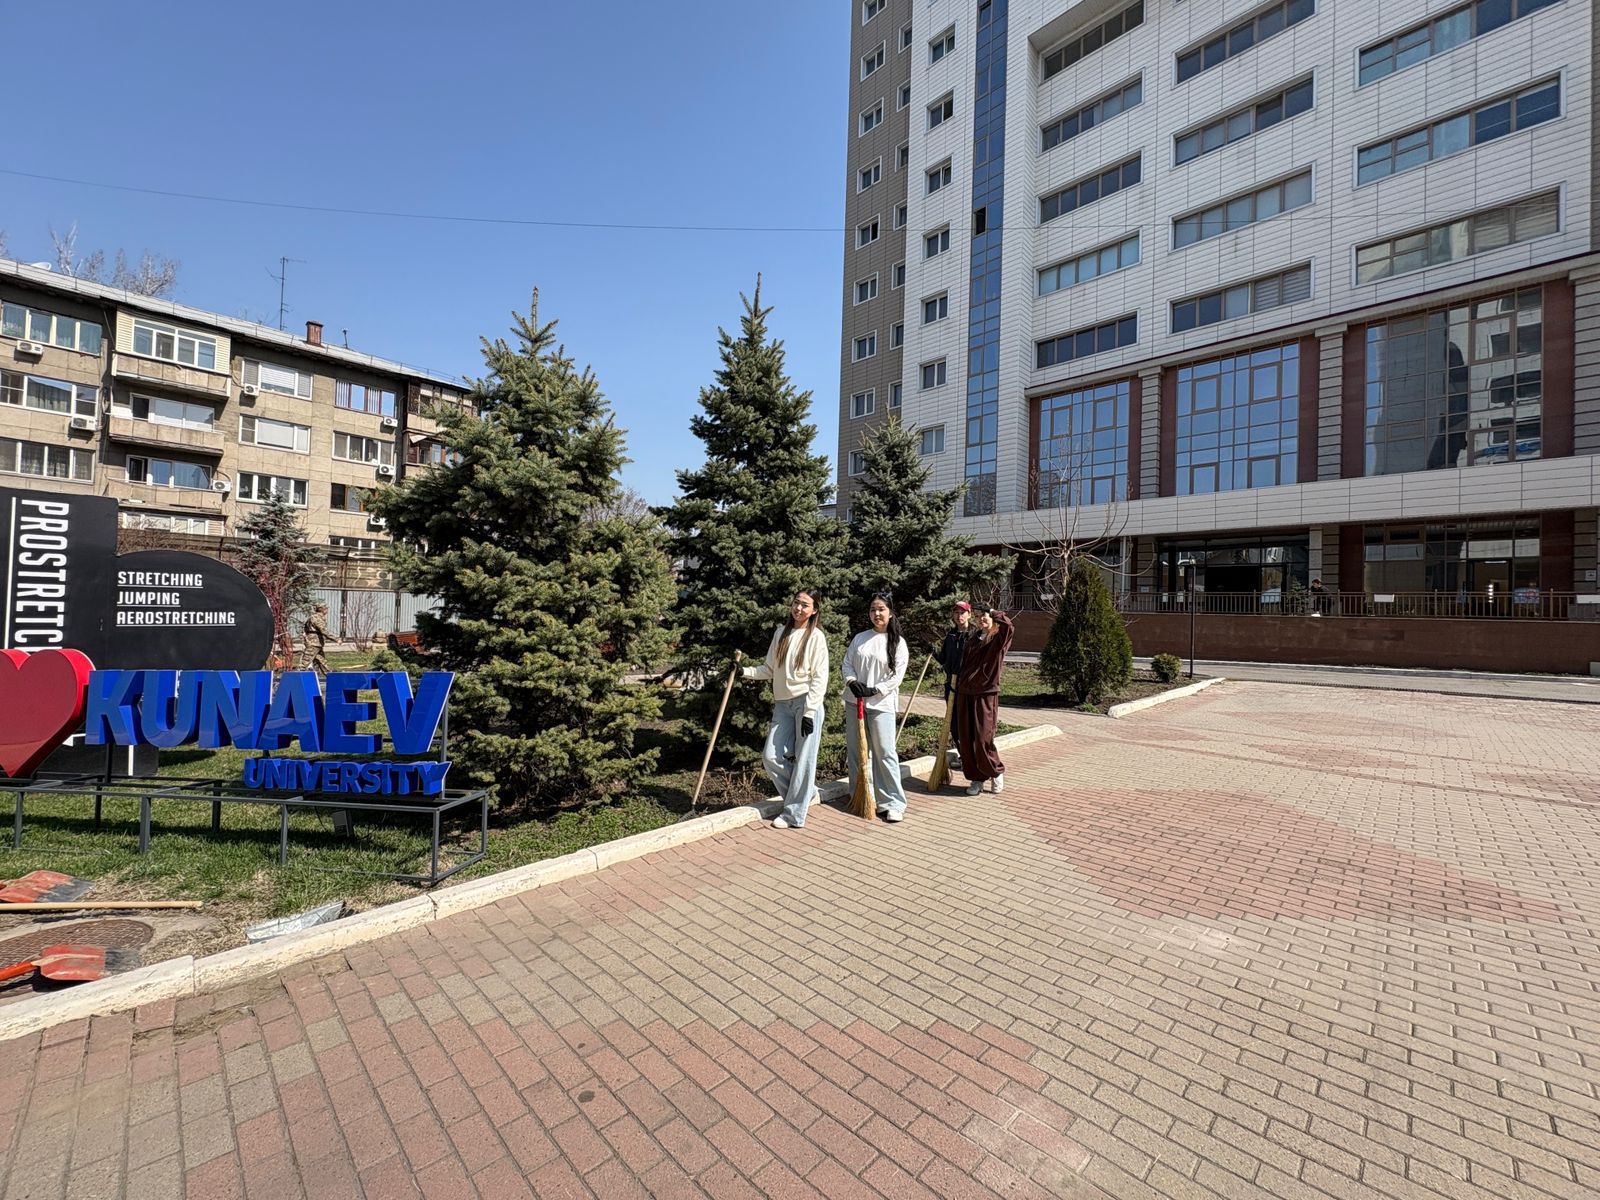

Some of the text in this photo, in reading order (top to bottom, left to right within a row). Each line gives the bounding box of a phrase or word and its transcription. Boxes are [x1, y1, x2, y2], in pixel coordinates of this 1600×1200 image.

[118, 571, 203, 587] STRETCHING
[117, 591, 180, 605] JUMPING
[116, 611, 236, 625] AEROSTRETCHING
[85, 670, 455, 755] KUNAEV
[243, 758, 453, 796] UNIVERSITY
